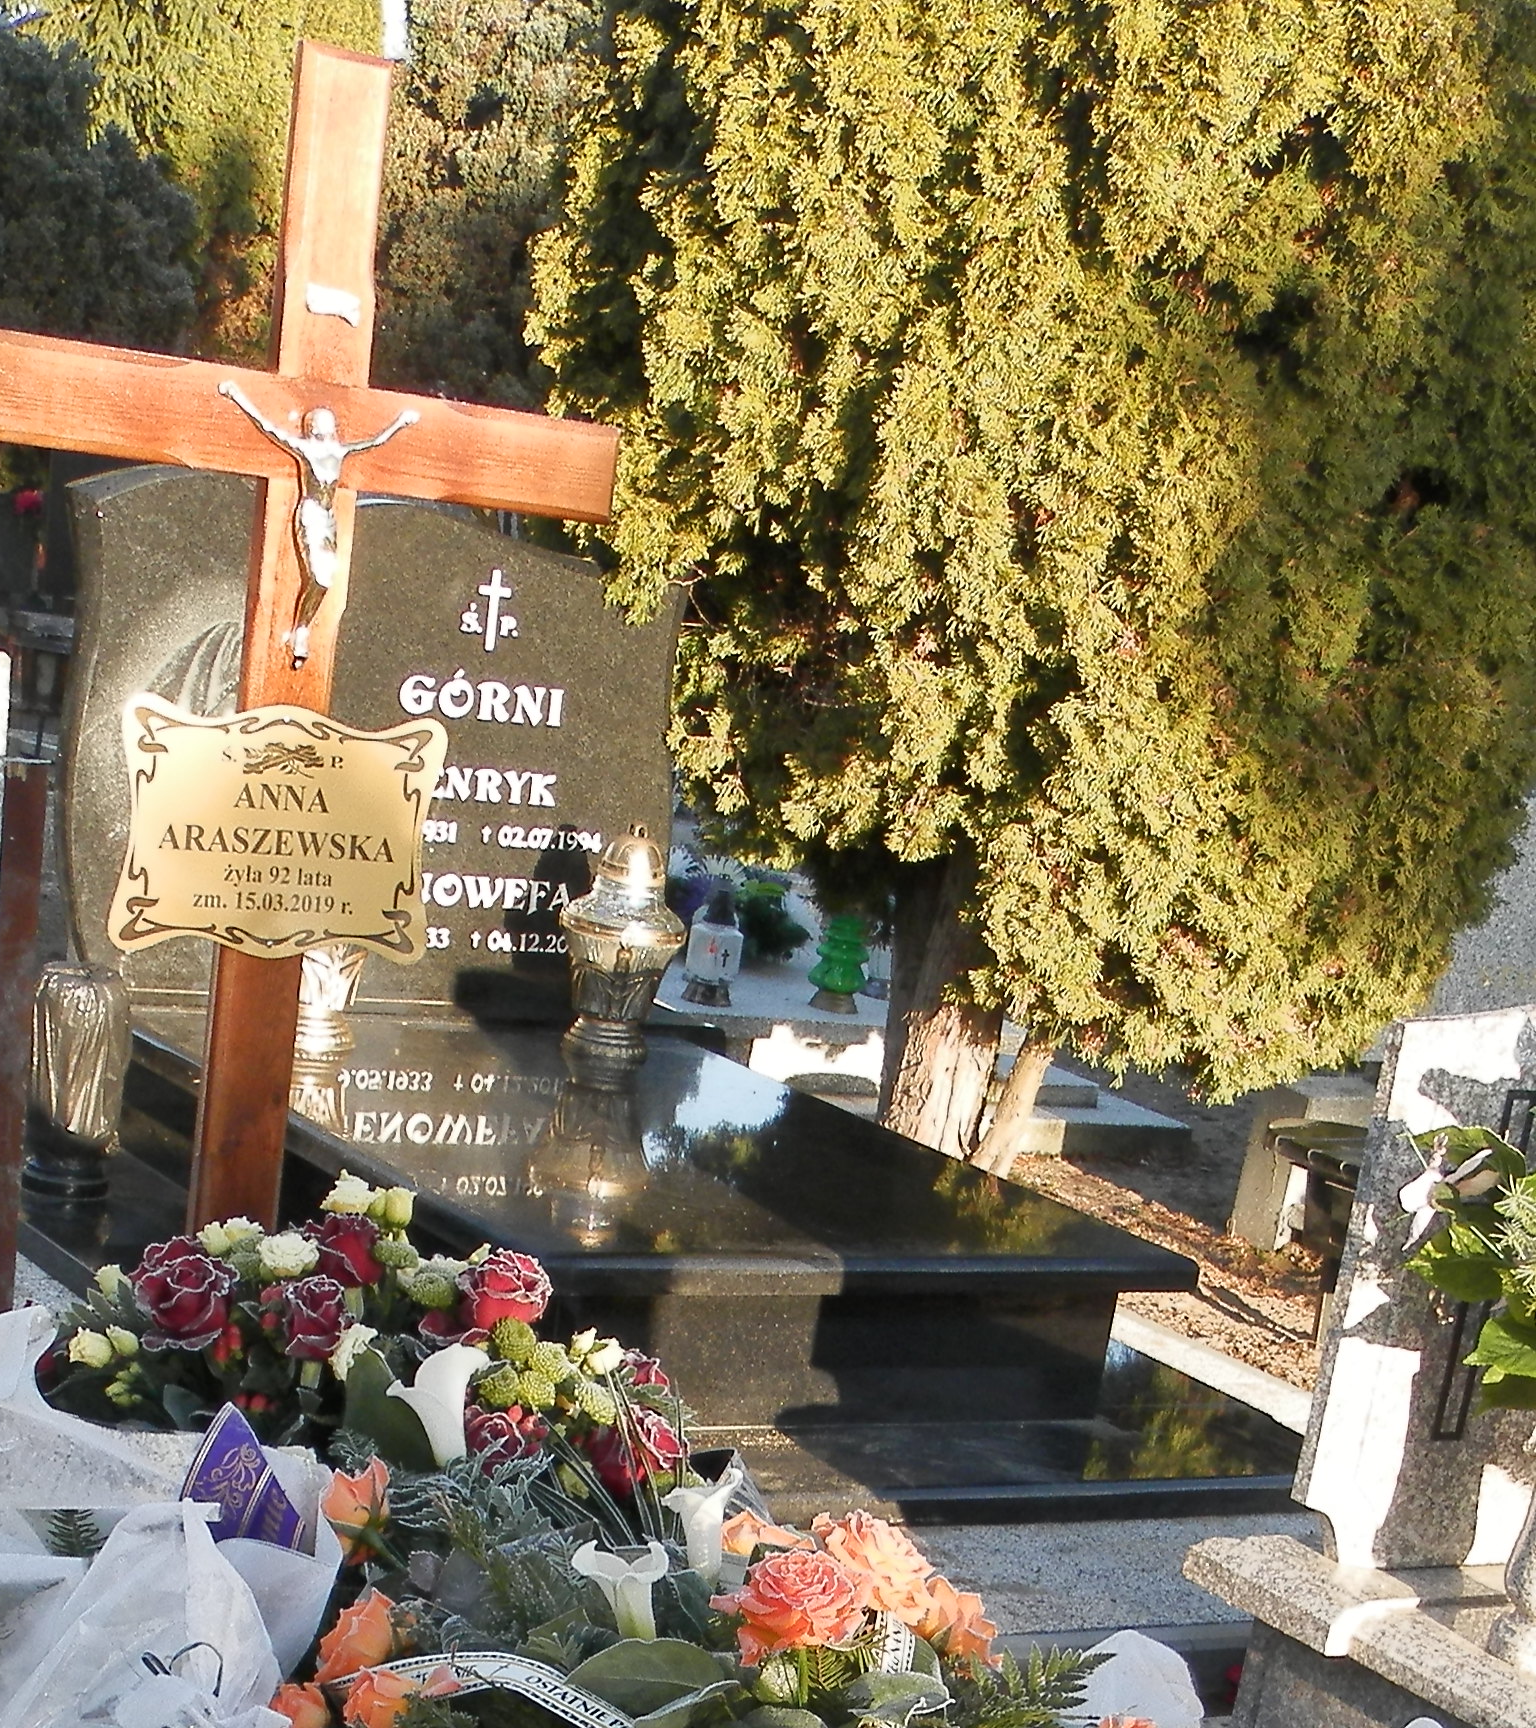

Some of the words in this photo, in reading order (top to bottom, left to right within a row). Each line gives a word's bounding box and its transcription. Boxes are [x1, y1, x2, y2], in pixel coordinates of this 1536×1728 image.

[399, 667, 564, 727] GÓRNI
[233, 782, 330, 814] ANNA
[431, 766, 557, 807] NRYK
[158, 823, 395, 864] ARASZEWSKA
[422, 819, 458, 844] 931
[496, 825, 603, 854] 02.07.1994
[223, 863, 262, 887] żyła
[268, 865, 291, 885] 92
[296, 867, 332, 888] lata
[192, 892, 227, 909] zm.
[235, 891, 335, 914] 15.03.2019
[340, 900, 353, 915] r.
[425, 926, 451, 949] 33
[486, 929, 569, 953] 04.12.20
[523, 1674, 610, 1726] OSTATNIE
